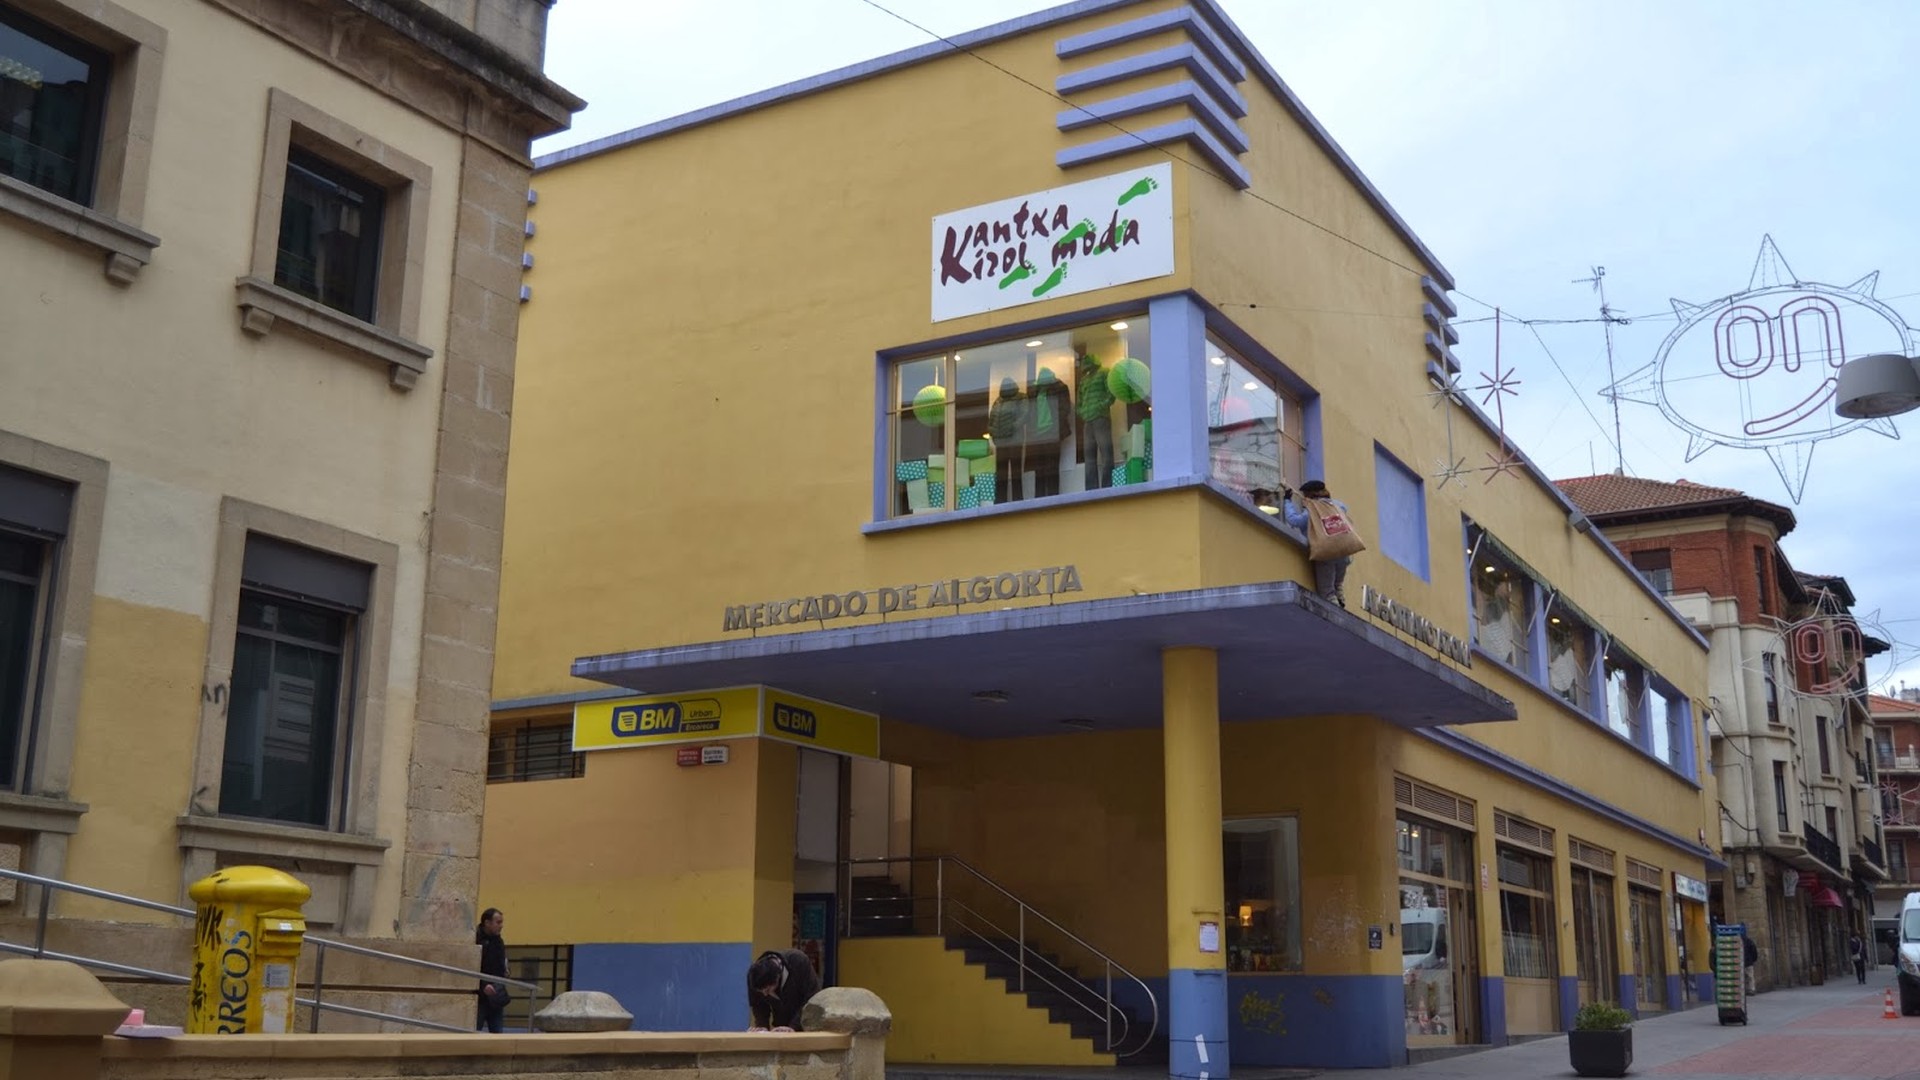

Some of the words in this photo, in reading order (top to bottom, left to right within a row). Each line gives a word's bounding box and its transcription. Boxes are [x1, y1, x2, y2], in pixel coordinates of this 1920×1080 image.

[941, 200, 1069, 286] Kantxa
[1051, 209, 1140, 268] moda
[723, 590, 868, 632] MERCADO
[877, 584, 918, 614] DE
[927, 565, 1083, 608] ALGORTA
[640, 707, 676, 731] BM
[689, 710, 714, 719] Urban
[791, 714, 813, 733] BM
